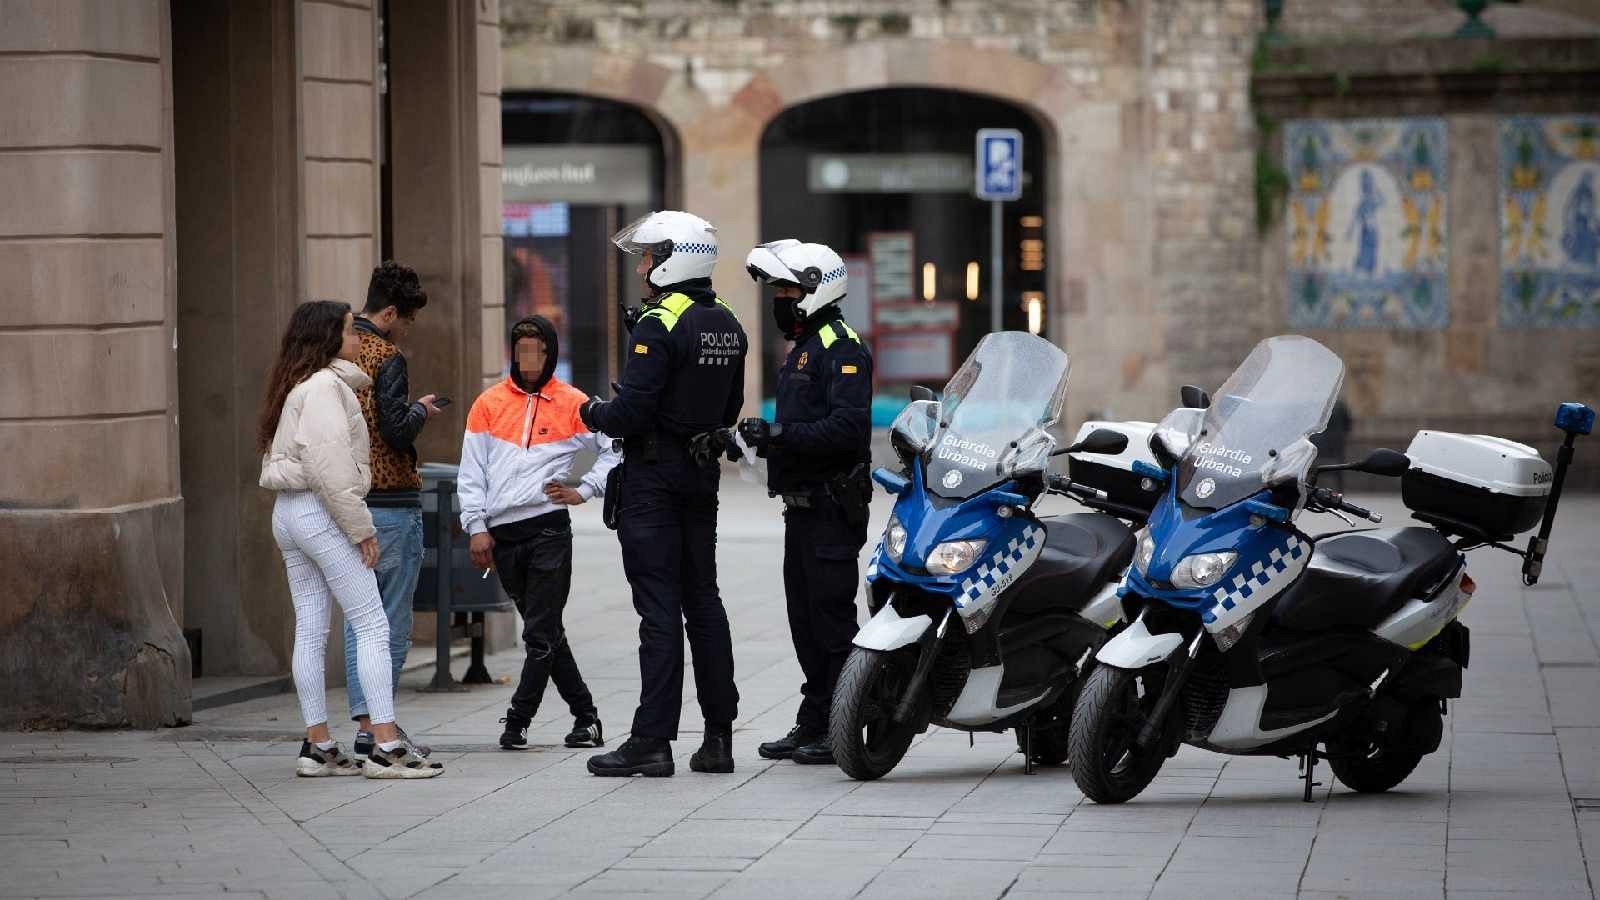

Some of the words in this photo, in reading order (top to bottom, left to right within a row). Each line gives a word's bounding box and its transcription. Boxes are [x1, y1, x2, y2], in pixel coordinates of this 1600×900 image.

[700, 332, 740, 347] POLICIA
[938, 447, 986, 471] Urbana
[1193, 455, 1242, 478] Urbana
